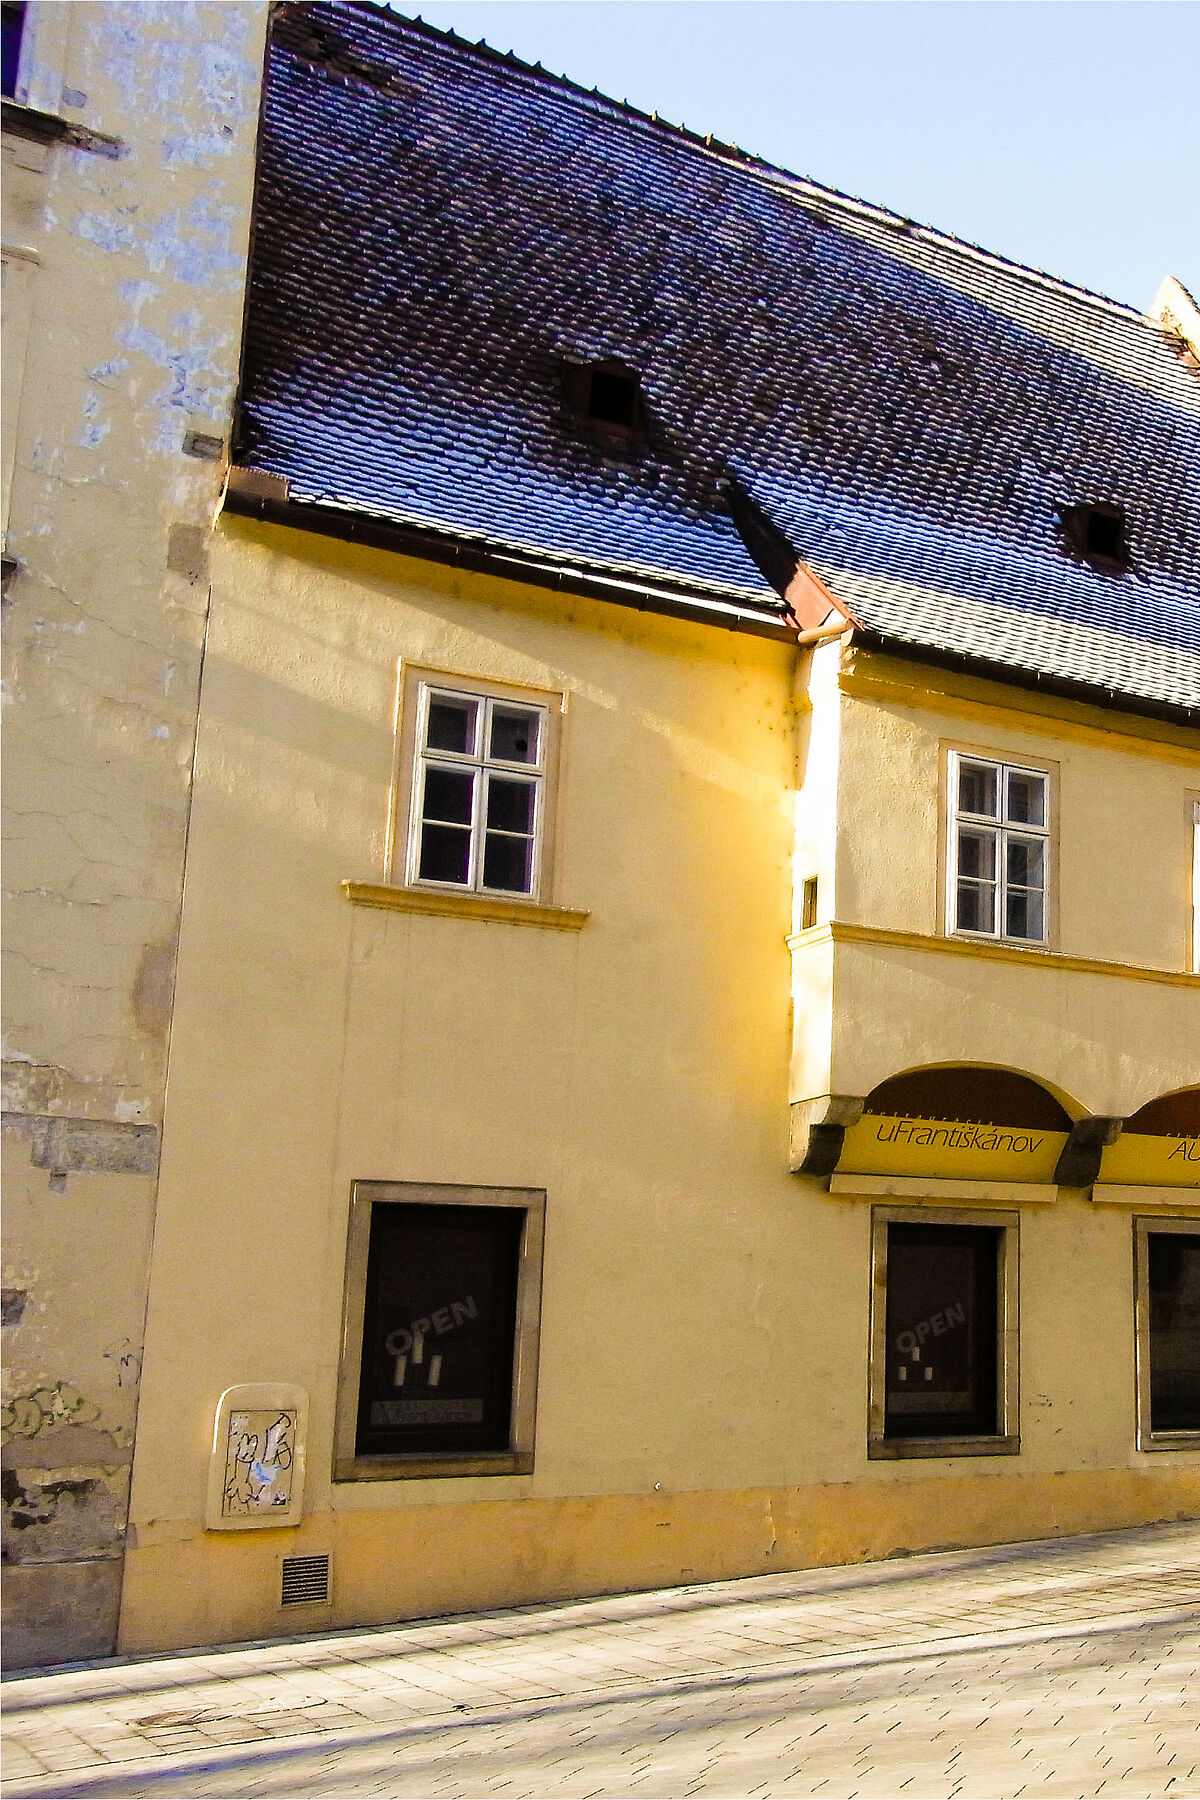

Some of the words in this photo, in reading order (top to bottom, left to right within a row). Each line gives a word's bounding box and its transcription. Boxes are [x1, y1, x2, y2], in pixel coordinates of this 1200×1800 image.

[876, 1120, 1044, 1152] uFrantiškánov
[386, 1295, 479, 1356] OPEN
[896, 1301, 966, 1353] OPEN
